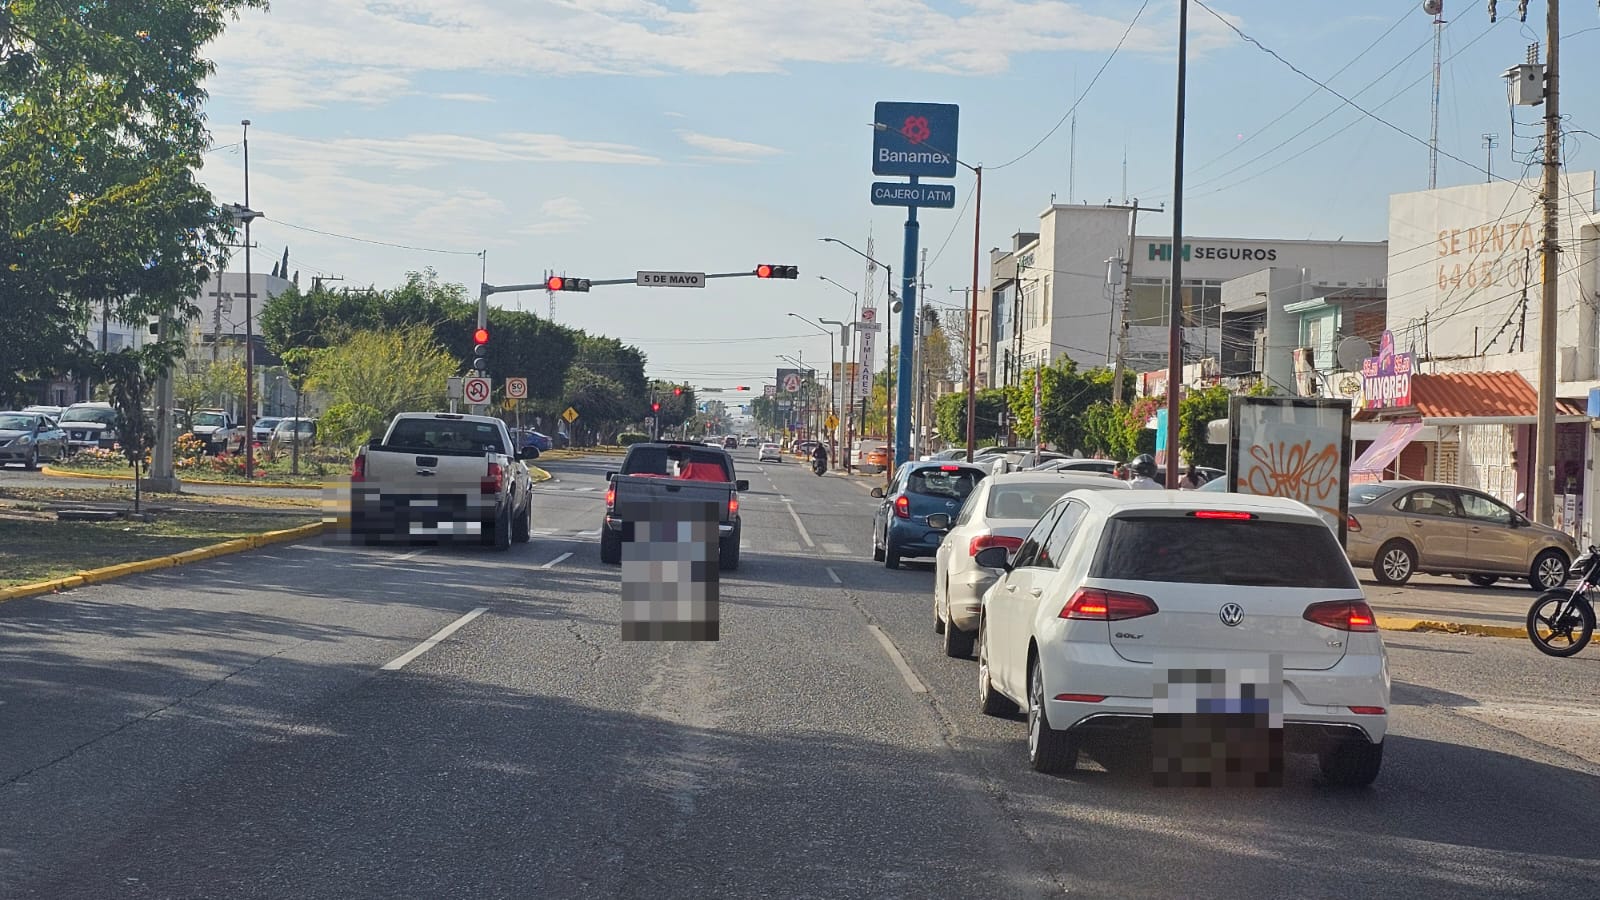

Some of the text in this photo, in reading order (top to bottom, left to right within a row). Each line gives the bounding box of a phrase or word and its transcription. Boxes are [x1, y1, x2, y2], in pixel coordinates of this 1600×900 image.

[879, 148, 950, 164] Banamex
[875, 188, 951, 201] CAJERO ATM
[1438, 222, 1535, 256] SE RENTA
[1194, 247, 1277, 261] SEGUROS
[644, 275, 698, 284] 5 DE MAYO
[862, 332, 872, 395] SIMILARES
[1366, 373, 1409, 400] MAYOREO
[1115, 631, 1144, 640] GOLF
